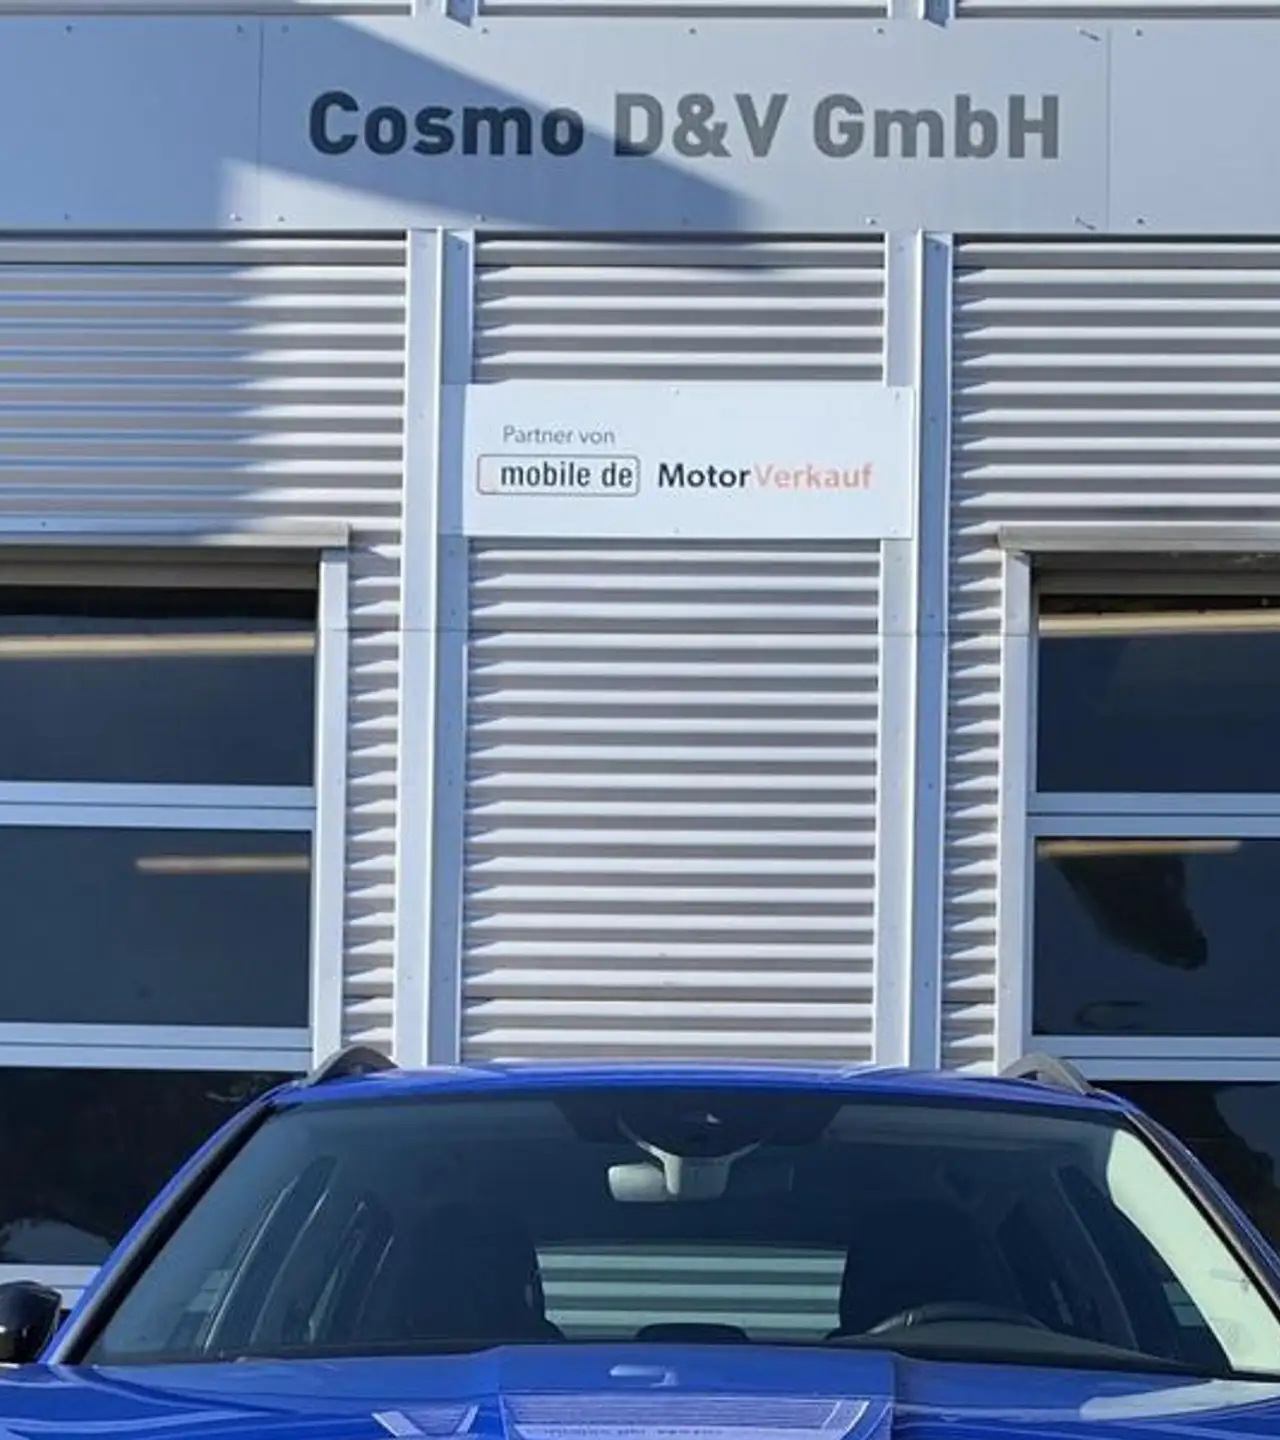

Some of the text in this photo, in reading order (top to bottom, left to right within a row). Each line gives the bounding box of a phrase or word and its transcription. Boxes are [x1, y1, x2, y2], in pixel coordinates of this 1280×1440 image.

[309, 91, 1061, 159] Cosmo D&V GmbH
[502, 425, 615, 446] Partner von
